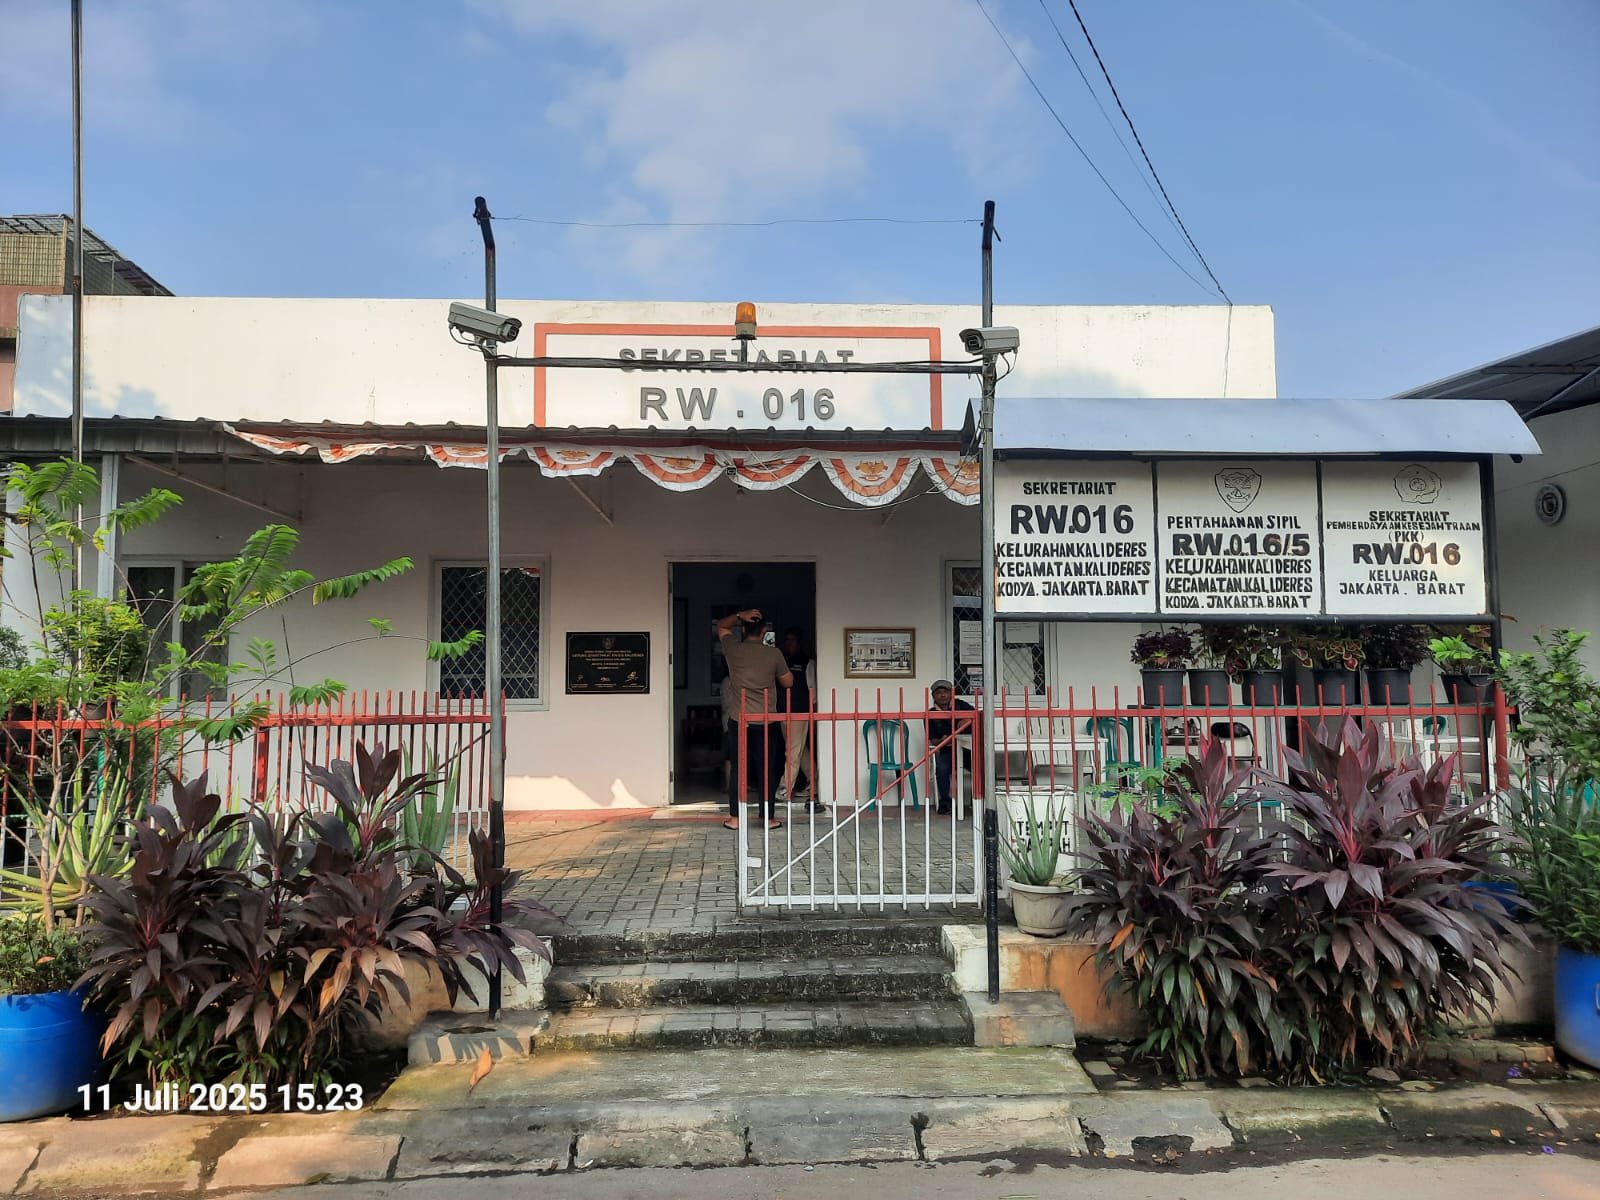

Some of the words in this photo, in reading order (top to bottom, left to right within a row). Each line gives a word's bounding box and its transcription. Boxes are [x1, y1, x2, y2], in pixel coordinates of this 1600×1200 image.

[640, 387, 717, 421] RW
[762, 388, 835, 421] 016
[1023, 481, 1116, 495] SEKRETARIAT
[1010, 504, 1134, 534] RW.016
[1369, 511, 1449, 521] SEKRETARIAT
[1389, 531, 1424, 542] (PKK)
[1172, 533, 1310, 556] RW.016/5
[1353, 543, 1461, 565] RW.016
[1369, 570, 1438, 582] KELUARGA
[1417, 583, 1465, 595] BARAT
[1017, 821, 1069, 836] TET
